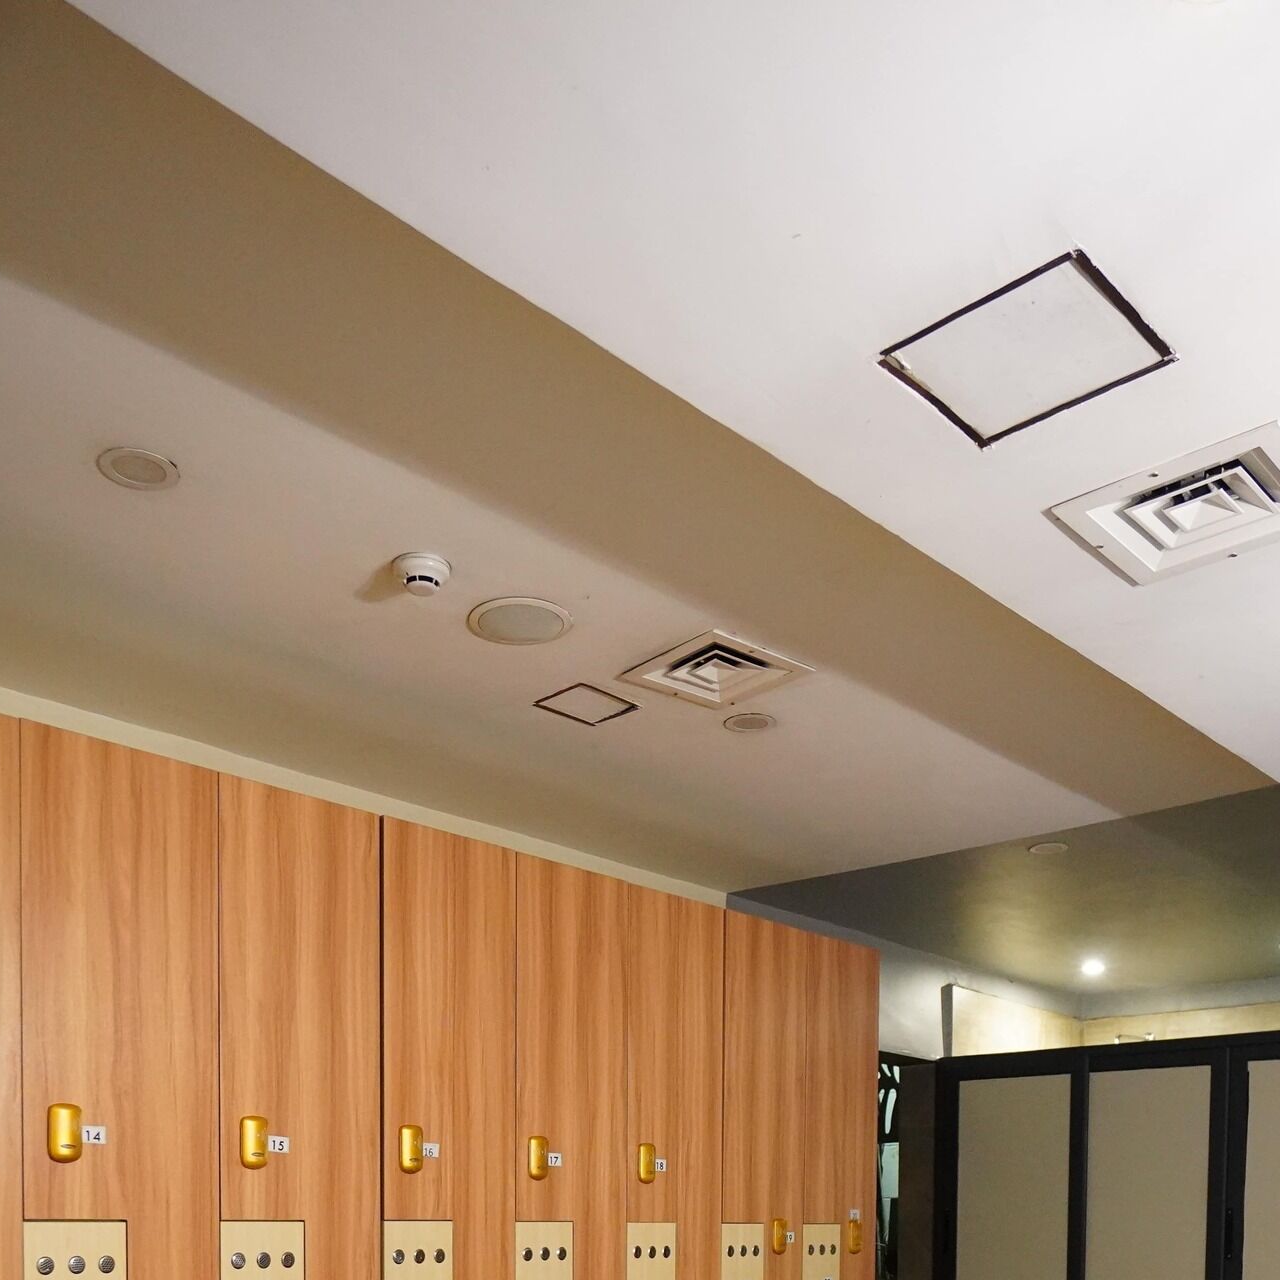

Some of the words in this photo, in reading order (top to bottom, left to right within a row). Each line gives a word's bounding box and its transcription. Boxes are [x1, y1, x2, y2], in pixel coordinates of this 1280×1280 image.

[86, 1130, 101, 1142] 14
[272, 1140, 285, 1151] 15
[424, 1148, 434, 1157] 16
[549, 1156, 559, 1165] 17
[656, 1161, 664, 1170] 18
